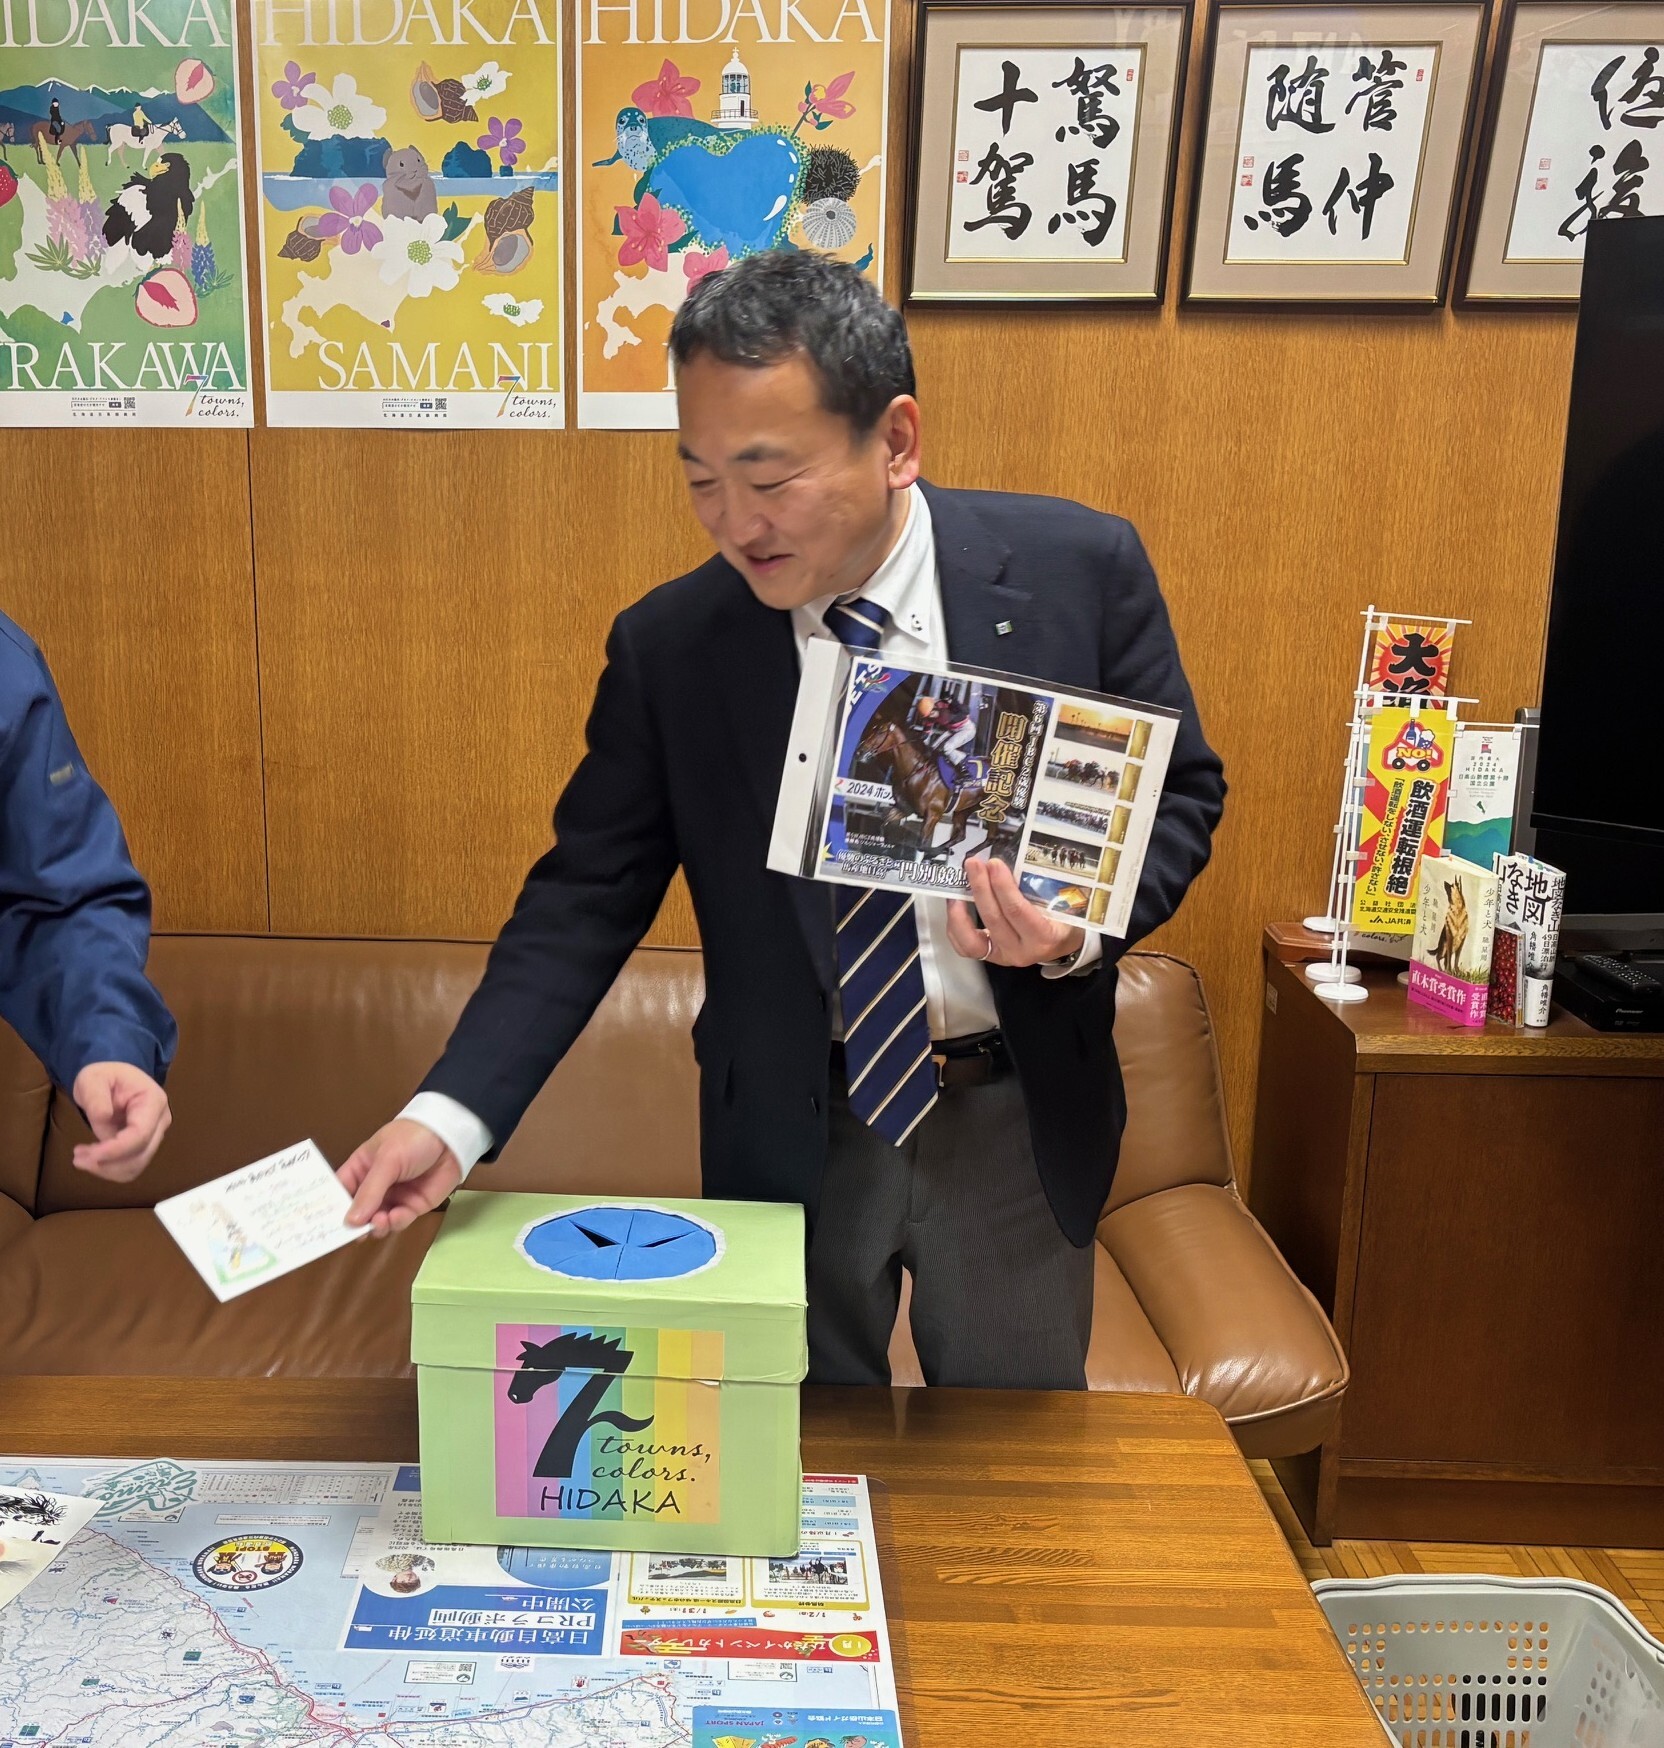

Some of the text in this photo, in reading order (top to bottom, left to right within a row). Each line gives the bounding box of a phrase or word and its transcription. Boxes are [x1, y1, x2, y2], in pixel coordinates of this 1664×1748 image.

[260, 0, 553, 46] HIDAKA
[583, 0, 884, 45] HIDAKA
[0, 342, 247, 391] RAKAWA
[318, 341, 554, 391] SAMANI
[198, 405, 239, 417] colors.
[200, 394, 245, 407] towns,
[509, 406, 551, 418] colors.
[511, 395, 556, 408] towns,
[977, 711, 1028, 823] 開催記念
[1396, 746, 1433, 759] NO!
[846, 782, 873, 796] 2024
[1385, 779, 1436, 896] 飲酒運転根絶
[1506, 861, 1526, 915] なき
[1522, 871, 1552, 927] 地図
[1547, 876, 1566, 932] 地図なき山
[1411, 970, 1467, 1006] 直木賞受賞作
[596, 1436, 711, 1464] towns,
[592, 1456, 696, 1483] colors.
[540, 1485, 681, 1516] HIDAKA
[522, 1597, 595, 1610] 公開中
[431, 1610, 593, 1627] PRコラボ動画
[388, 1626, 589, 1645] 日高自動車道延伸
